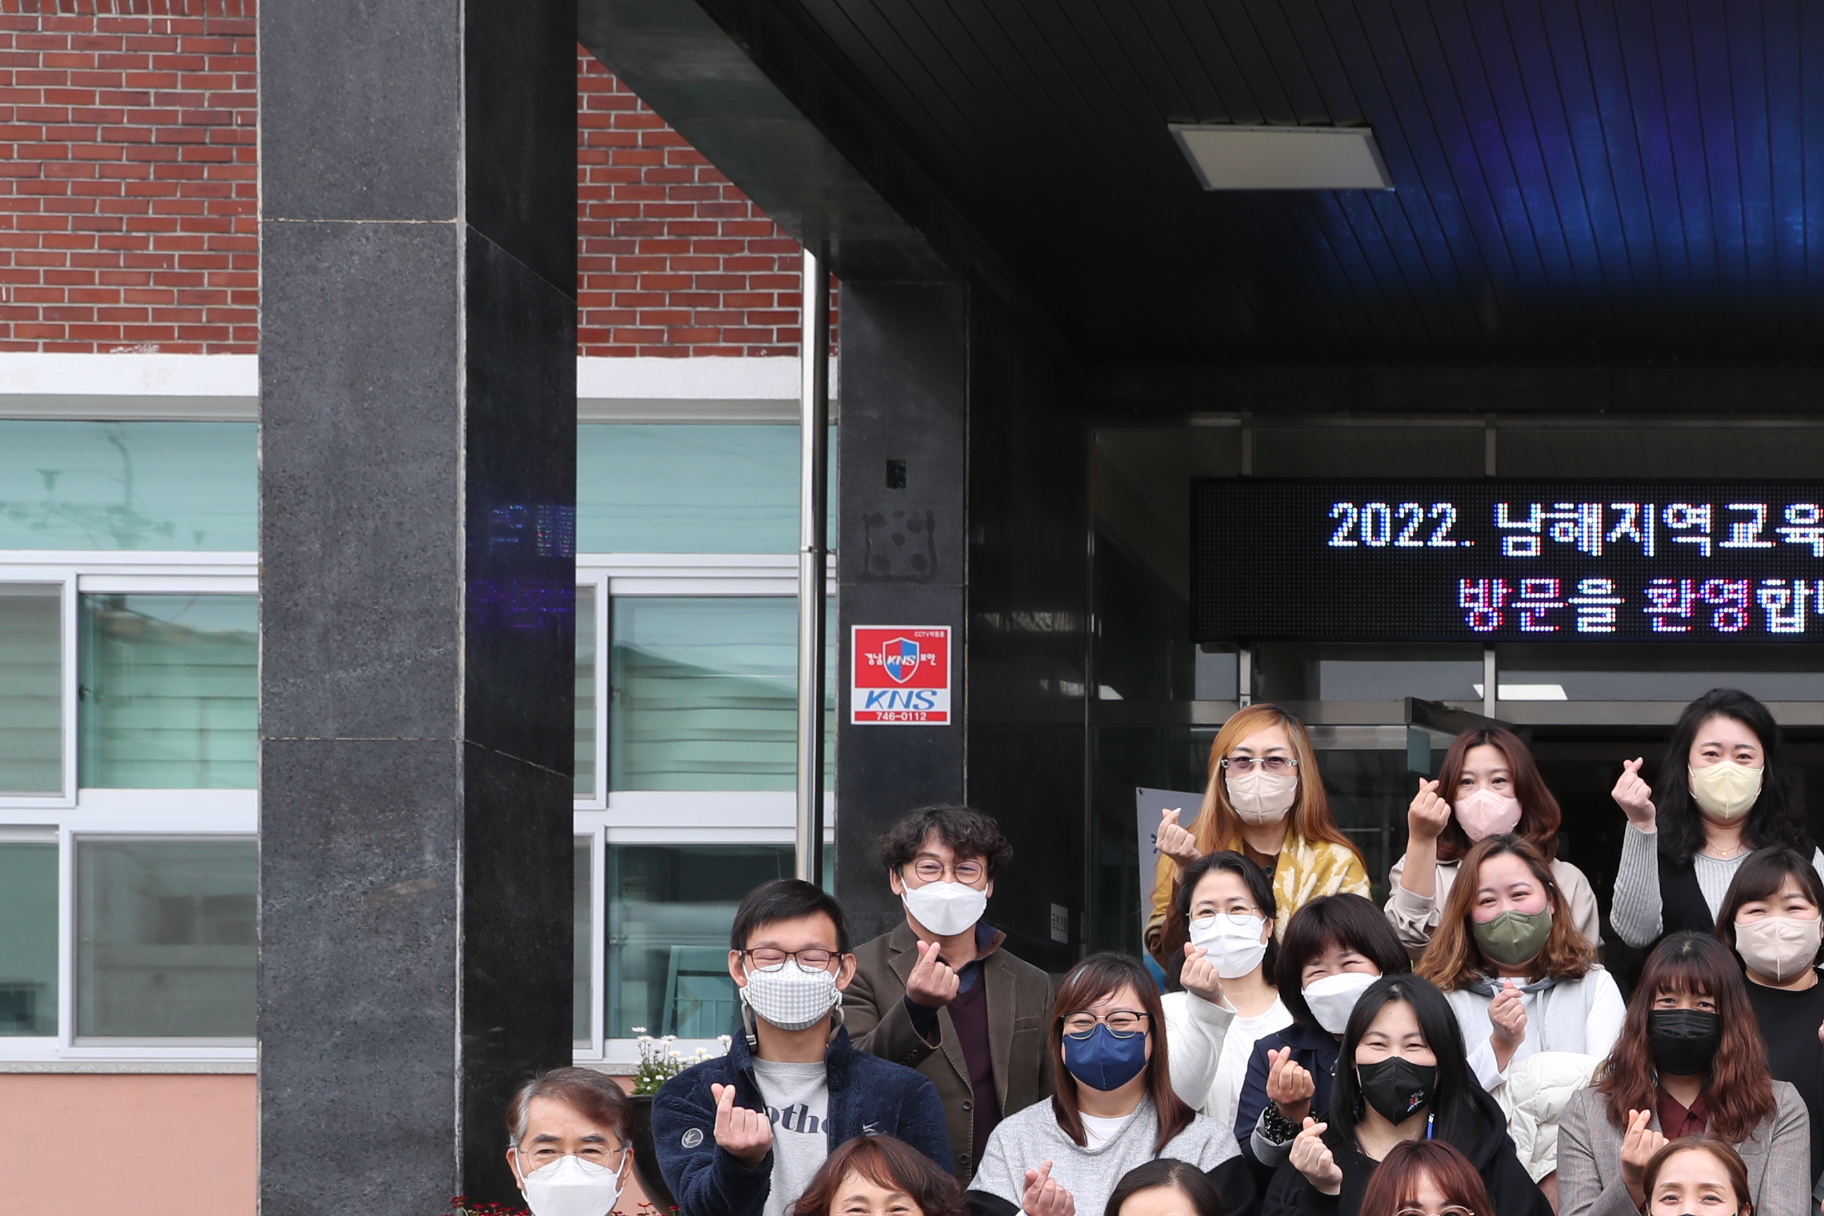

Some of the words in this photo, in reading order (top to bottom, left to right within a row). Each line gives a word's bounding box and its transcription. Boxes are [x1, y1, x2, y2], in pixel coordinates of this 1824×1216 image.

[1328, 502, 1476, 547] 2022.
[1458, 578, 1626, 633] 방문을
[864, 653, 883, 666] 경남
[886, 654, 917, 666] KNS
[920, 653, 937, 666] 보안
[865, 690, 938, 710] KNS
[876, 712, 927, 721] 746-0112
